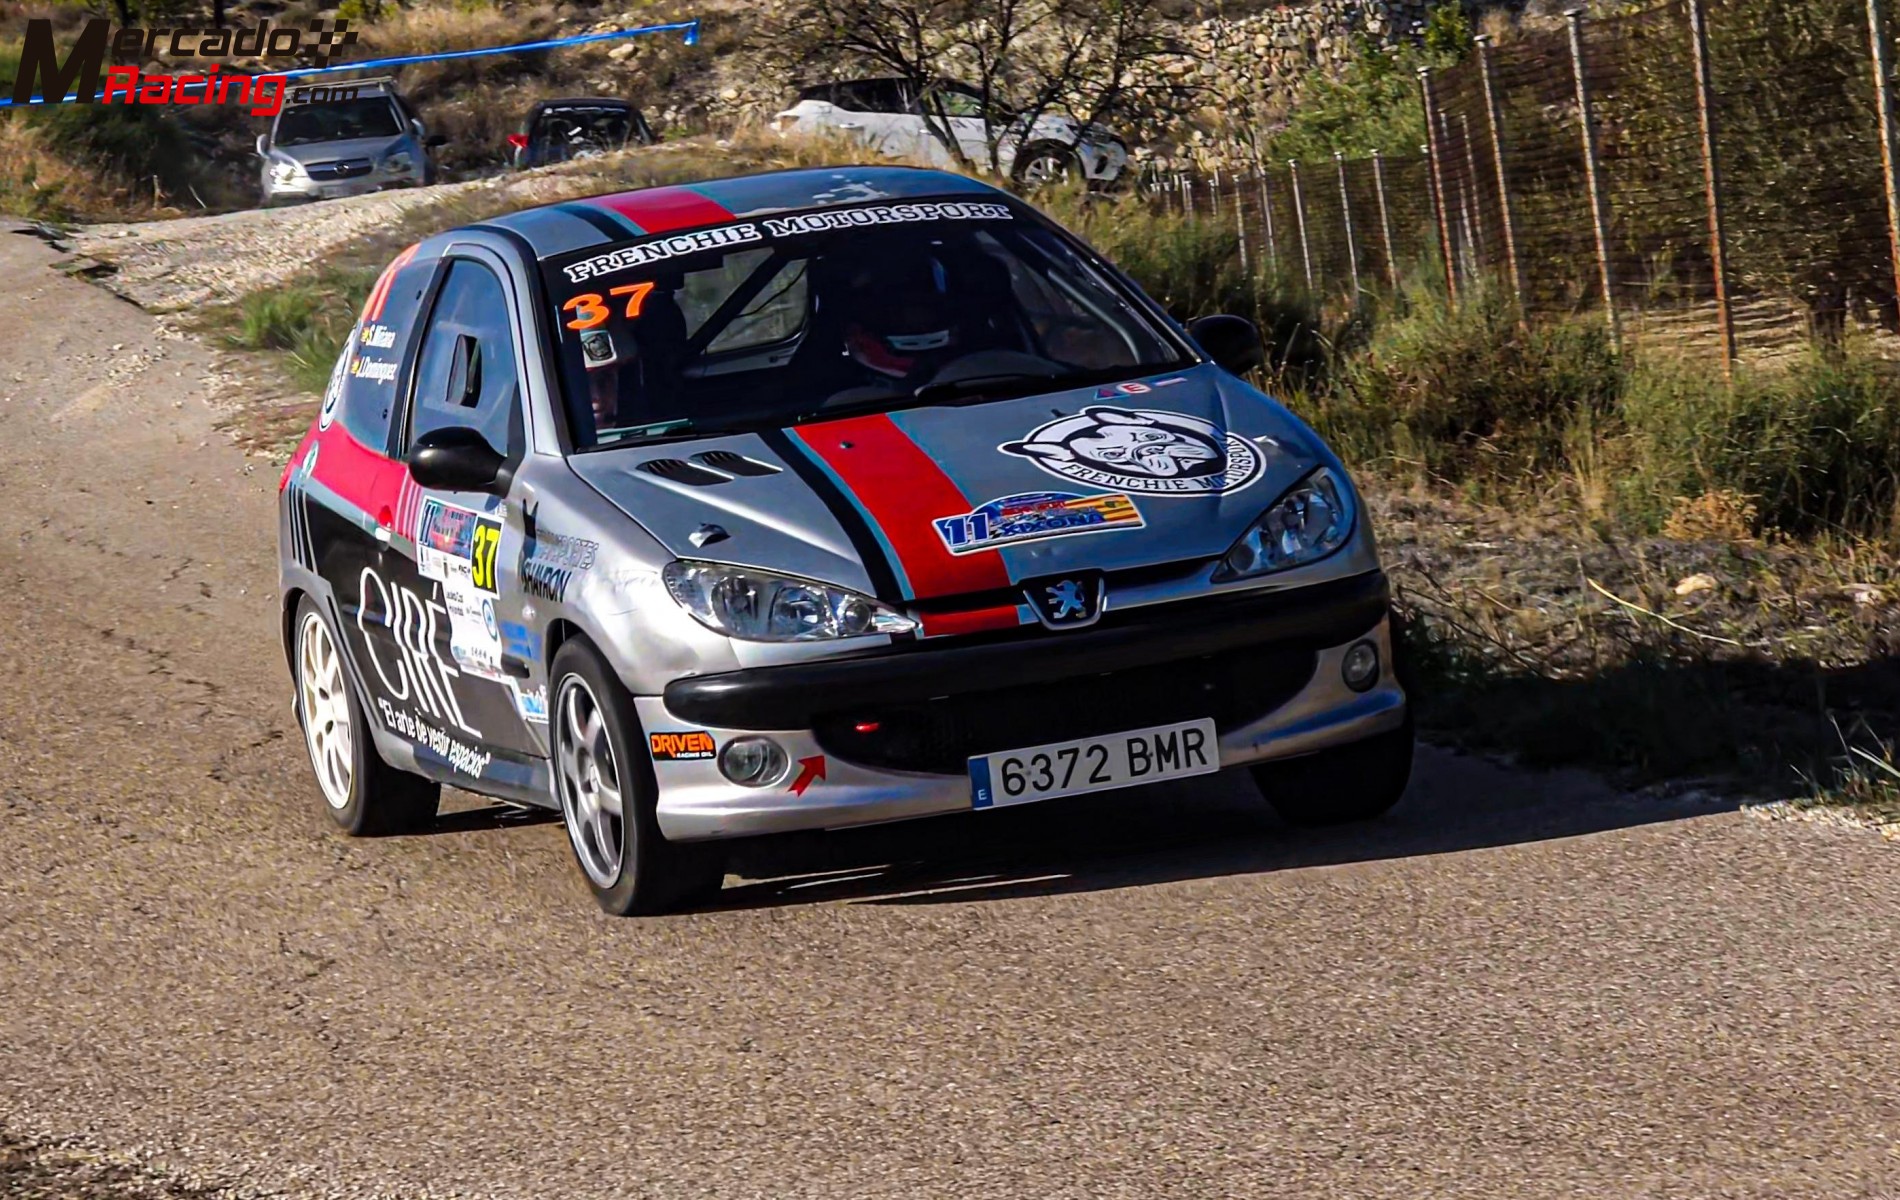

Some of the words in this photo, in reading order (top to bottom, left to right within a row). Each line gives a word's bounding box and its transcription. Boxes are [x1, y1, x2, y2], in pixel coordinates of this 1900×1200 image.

[563, 224, 762, 282] FRENCHIE
[763, 201, 1013, 237] MOTORSPORT
[563, 282, 655, 330] 37
[1061, 463, 1189, 490] FRENCHIE
[944, 513, 990, 546] 11
[472, 524, 501, 589] 37
[394, 709, 416, 739] arte
[652, 733, 716, 758] DRIVEN
[1001, 744, 1112, 797] 6372
[1127, 727, 1208, 778] BMR
[977, 788, 988, 801] E
